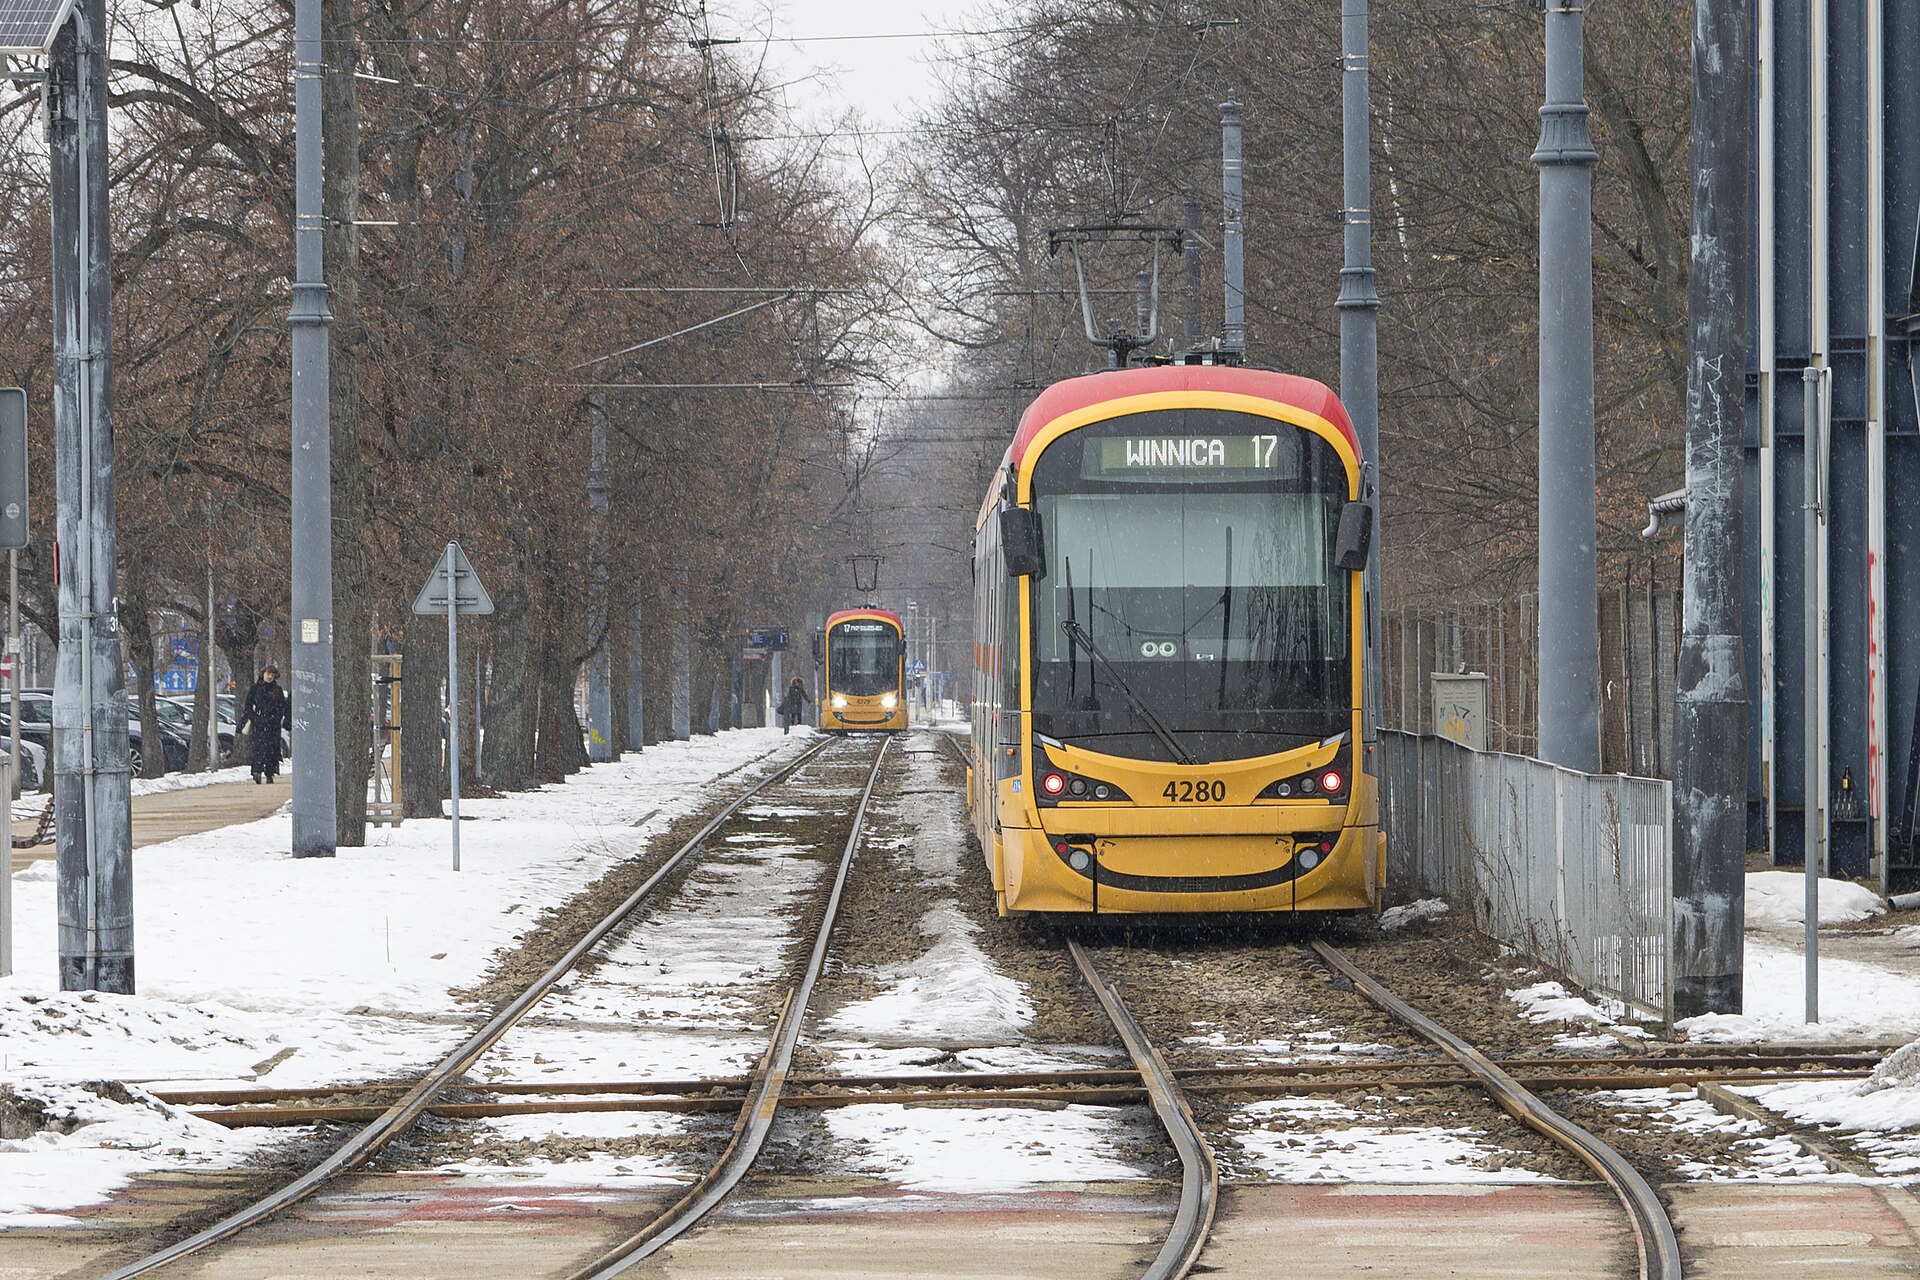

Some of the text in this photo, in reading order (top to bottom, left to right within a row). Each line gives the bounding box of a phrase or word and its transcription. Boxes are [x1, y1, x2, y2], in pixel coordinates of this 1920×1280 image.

[1126, 435, 1278, 468] WINNICA 17
[1162, 780, 1226, 802] 4280
